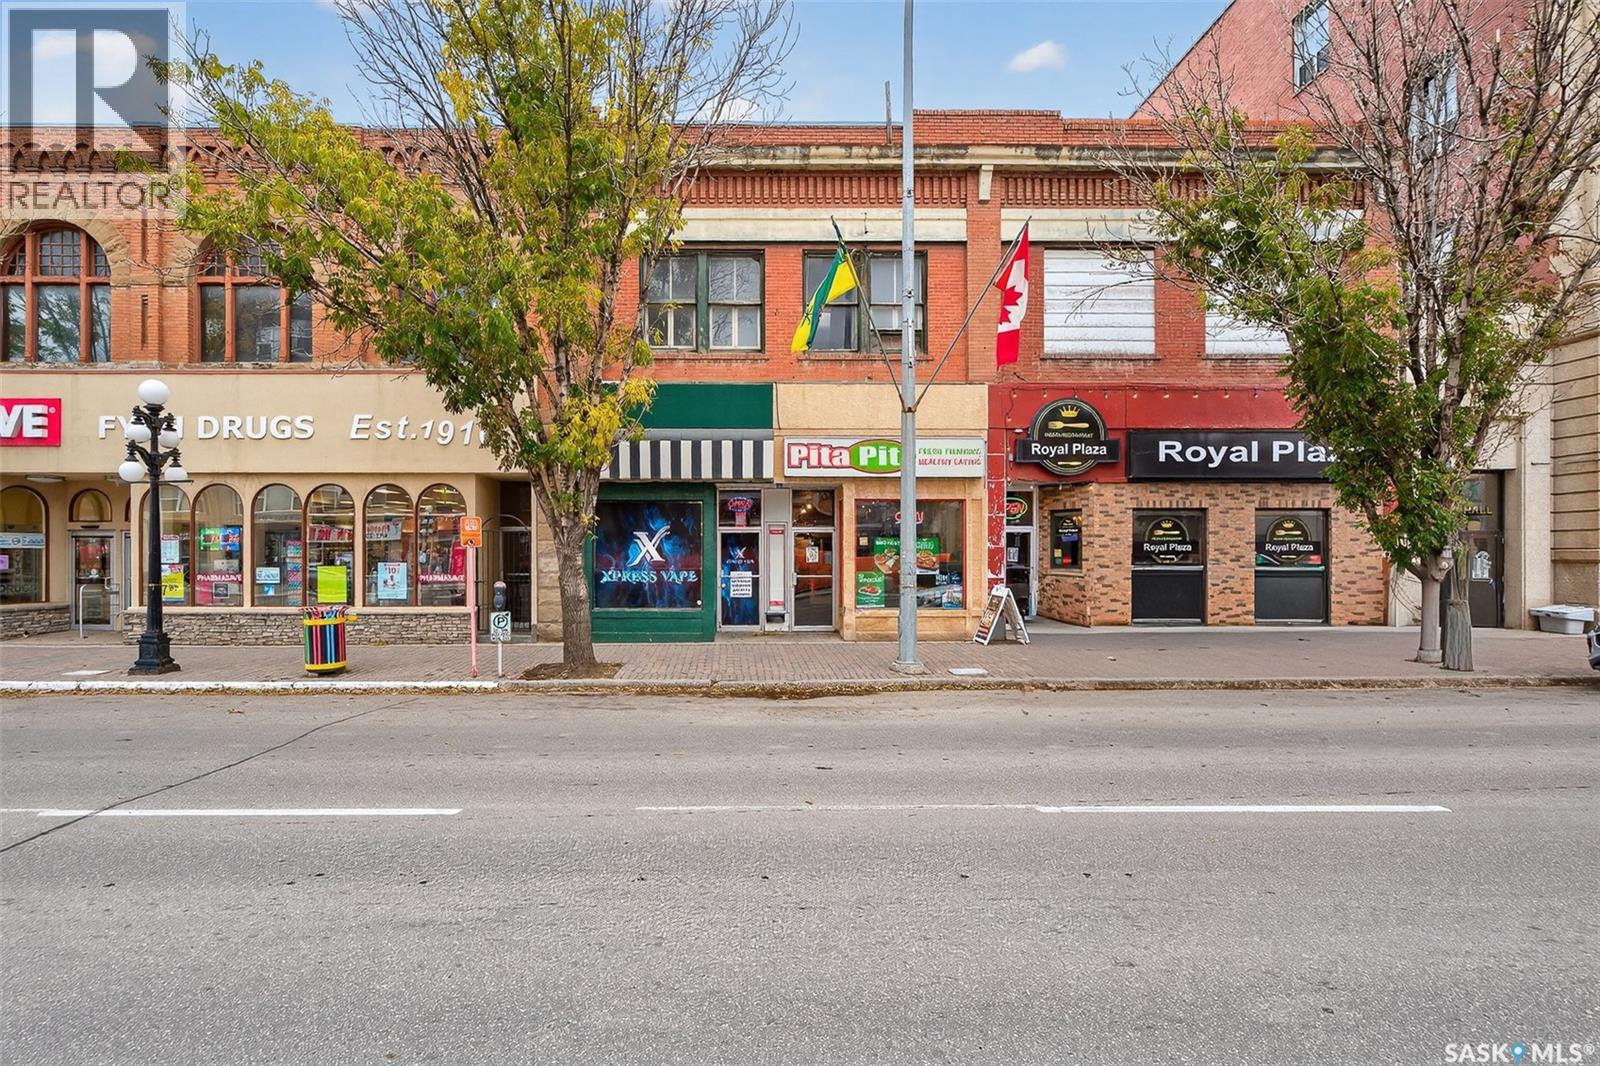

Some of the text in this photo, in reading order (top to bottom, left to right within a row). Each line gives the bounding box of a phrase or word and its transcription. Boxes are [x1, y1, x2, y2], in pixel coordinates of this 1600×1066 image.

[197, 415, 315, 440] DRUGS
[789, 445, 901, 467] Pita Pit
[1031, 442, 1107, 458] Royal Plaza
[1158, 440, 1341, 468] Royal Pla
[1143, 543, 1192, 552] Royal Plaza
[1265, 543, 1314, 552] Royal Plaza
[600, 569, 698, 584] XPRESS VAPE
